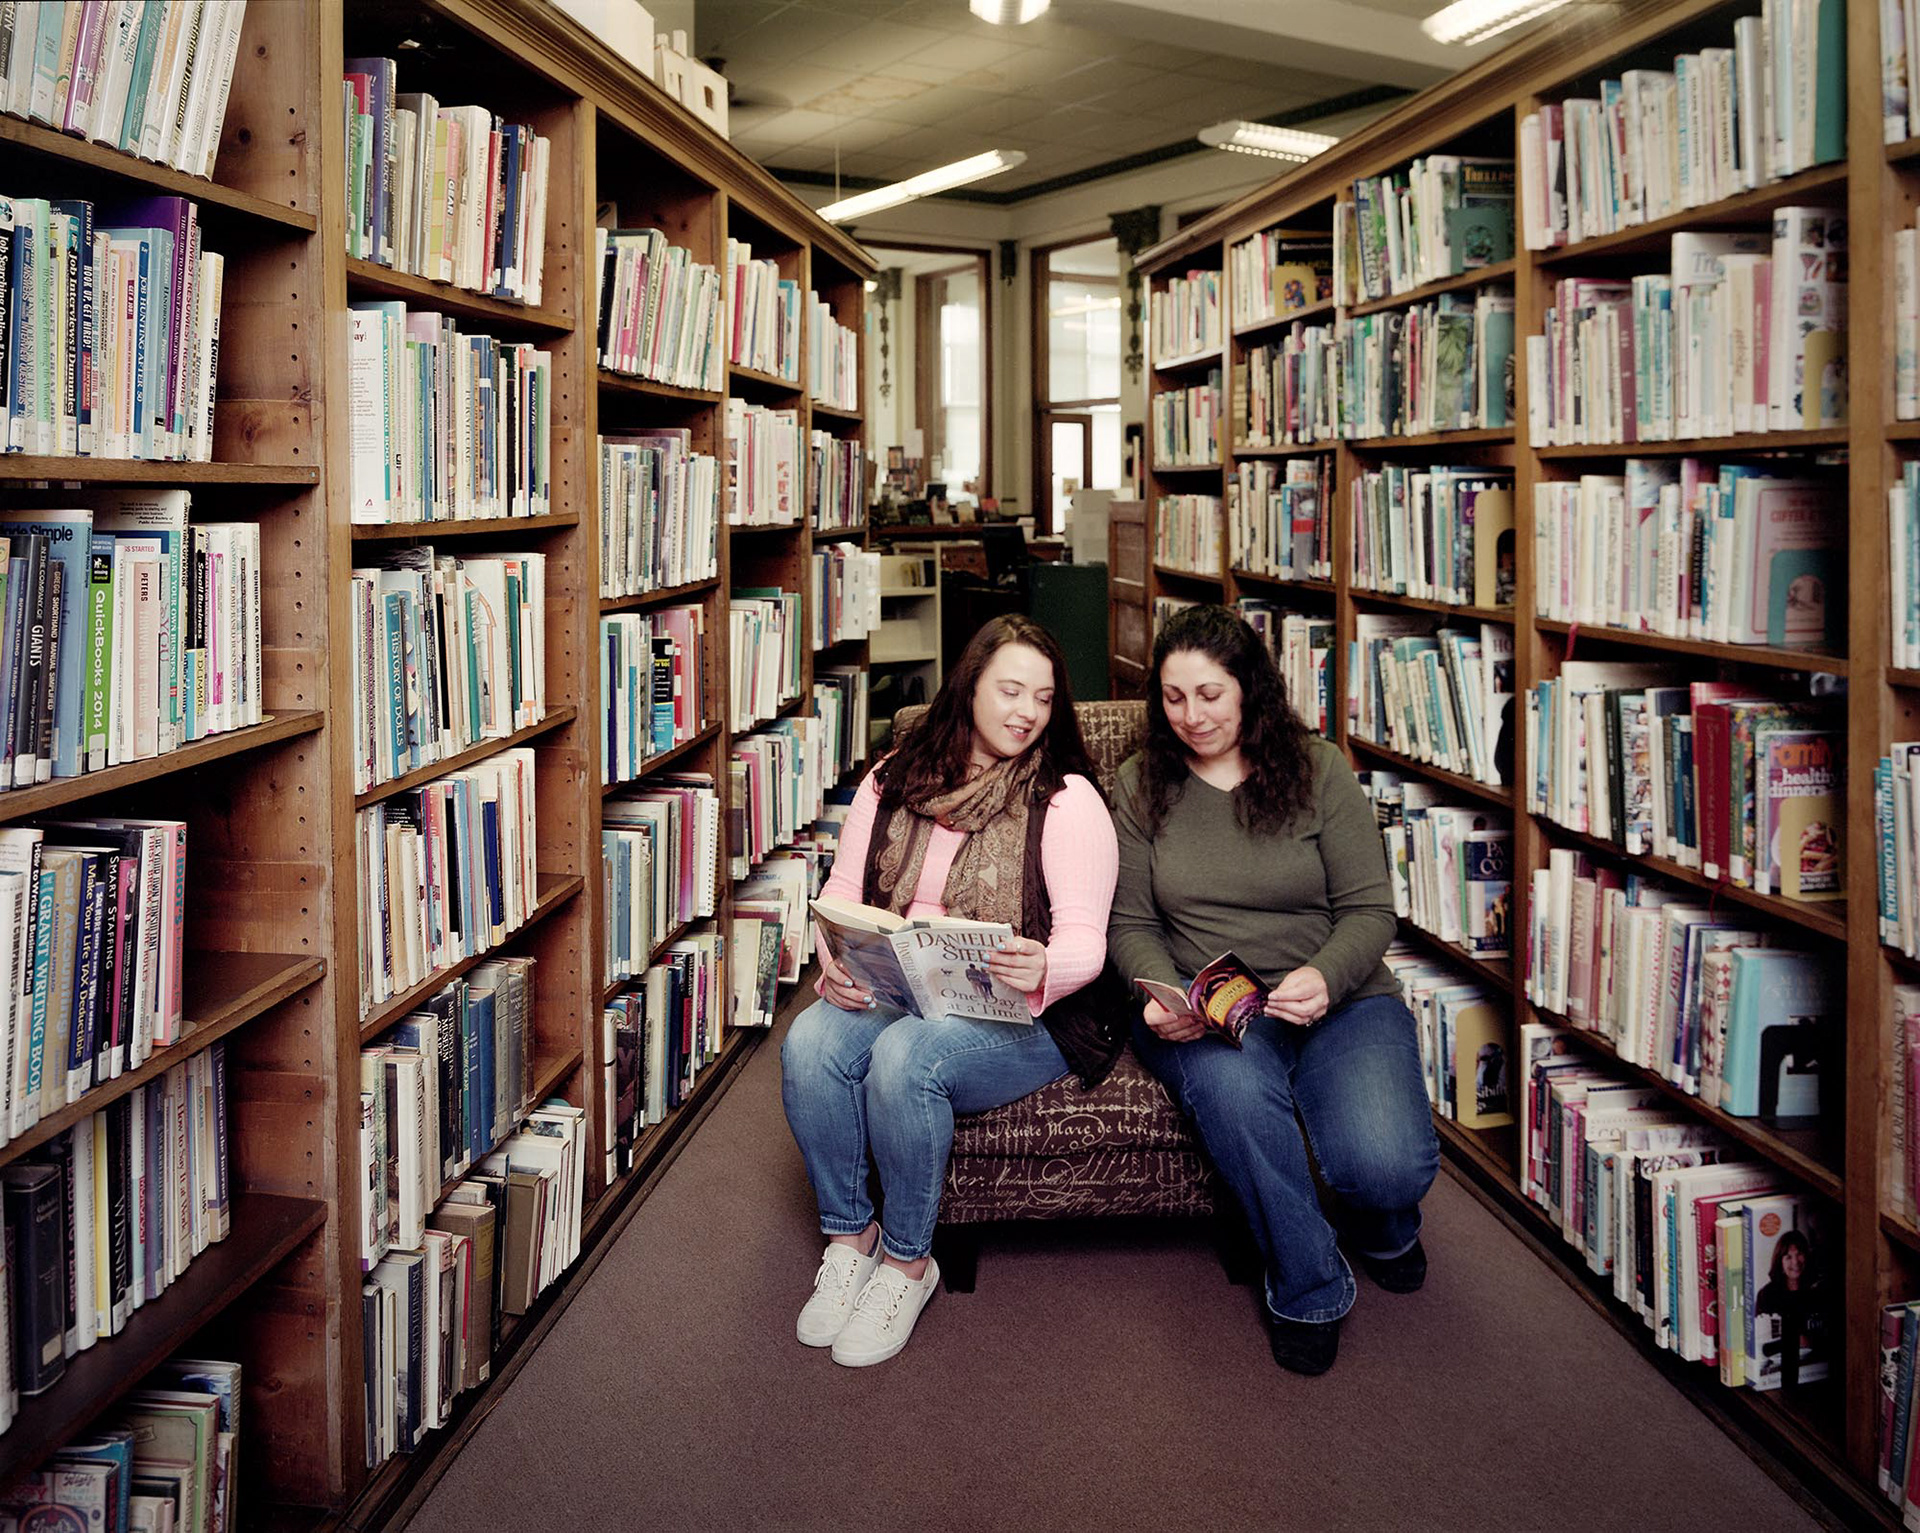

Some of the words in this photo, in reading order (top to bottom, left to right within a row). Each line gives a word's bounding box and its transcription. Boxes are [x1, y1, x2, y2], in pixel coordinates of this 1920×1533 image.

[177, 71, 192, 126] Dummies
[210, 123, 221, 144] Way
[382, 152, 390, 192] CLOCKS
[446, 179, 454, 215] GEAR
[0, 236, 9, 253] Job
[188, 217, 197, 277] RESUMES!
[0, 255, 9, 306] Searching
[22, 263, 32, 300] ANSWERS
[68, 252, 77, 276] Job
[83, 265, 92, 287] HOOK
[83, 290, 92, 302] UP,
[139, 275, 147, 294] JOB
[67, 278, 77, 345] Interviews
[83, 303, 92, 319] GET
[138, 296, 147, 350] HUNTING
[184, 283, 193, 341] RESUMES!
[20, 321, 29, 363] INTERVIEW
[82, 321, 92, 349] HIRED!
[18, 363, 27, 404] QUESTIONS
[67, 353, 76, 414] Dummies
[180, 348, 190, 408] RESUMES!
[131, 545, 155, 553] STARTED
[170, 548, 178, 576] START
[37, 569, 45, 608] COMPANY
[52, 571, 61, 594] GREGG
[141, 572, 149, 602] PETERS
[170, 579, 178, 604] YOUR
[50, 597, 60, 638] SHORTHAND
[197, 594, 205, 639] Business
[29, 624, 44, 667] GIANTS
[48, 642, 58, 671] MANUAL
[93, 590, 106, 687] QuickBooks
[169, 633, 177, 677] BUSINESS
[391, 631, 403, 684] HISTORY
[230, 640, 238, 678] BUSINESS
[47, 672, 57, 711] SIMPLIFIED
[93, 691, 105, 730] 2014
[393, 687, 403, 701] OF
[395, 706, 404, 746] DOLLS
[1881, 776, 1893, 835] HOLIDAY
[33, 844, 42, 868] How
[63, 859, 78, 914] Cost
[84, 864, 97, 900] Make
[108, 856, 119, 899] SMART
[145, 871, 153, 903] BREAK
[175, 857, 185, 925] IDIOT'S
[1885, 839, 1898, 916] COOKBOOK
[30, 882, 40, 913] Write
[37, 895, 52, 956] GRANT
[82, 902, 94, 932] Your
[26, 924, 38, 968] Business
[81, 935, 92, 959] Life
[105, 906, 117, 970] STAFFING
[915, 932, 1008, 950] DANIELLE
[79, 961, 91, 987] TAX
[142, 950, 150, 982] RULES
[895, 941, 915, 975] DANIELLE
[1670, 944, 1683, 1001] 12,167
[24, 970, 34, 994] Plan
[56, 918, 76, 1040] Accounting:
[31, 961, 49, 1046] WRITING
[940, 988, 977, 1004] One
[983, 991, 1017, 1010] Day
[947, 1001, 961, 1011] at
[981, 1003, 1023, 1020] Time
[75, 991, 89, 1057] Deductible
[216, 1063, 224, 1117] Marketing
[175, 1103, 185, 1128] How
[176, 1130, 185, 1145] to
[175, 1150, 186, 1171] Say
[66, 1156, 75, 1242] LEADING
[179, 1199, 189, 1232] Work
[412, 1269, 421, 1322] KENNETH
[412, 1325, 420, 1362] CLARK
